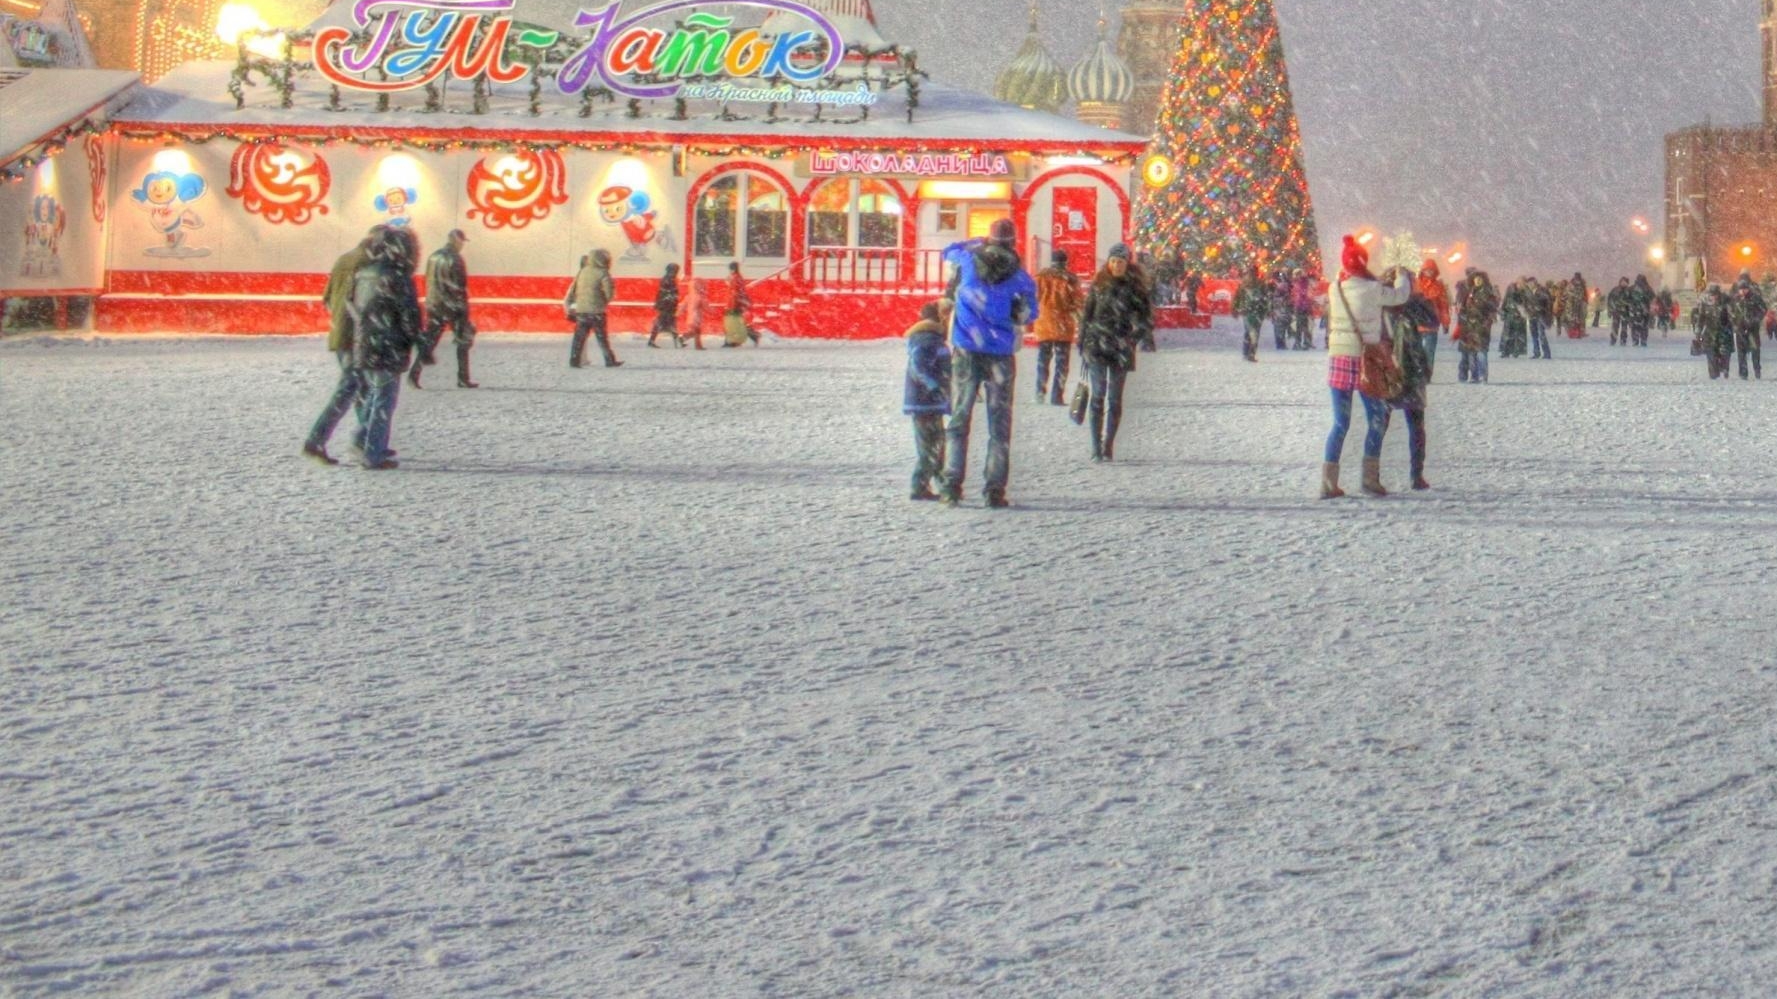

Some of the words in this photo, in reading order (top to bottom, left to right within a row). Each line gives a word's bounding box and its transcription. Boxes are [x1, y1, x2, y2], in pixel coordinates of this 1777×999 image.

[680, 84, 704, 99] на
[706, 82, 793, 106] Красной
[810, 150, 1008, 175] ШОКОЛАДНИЦА
